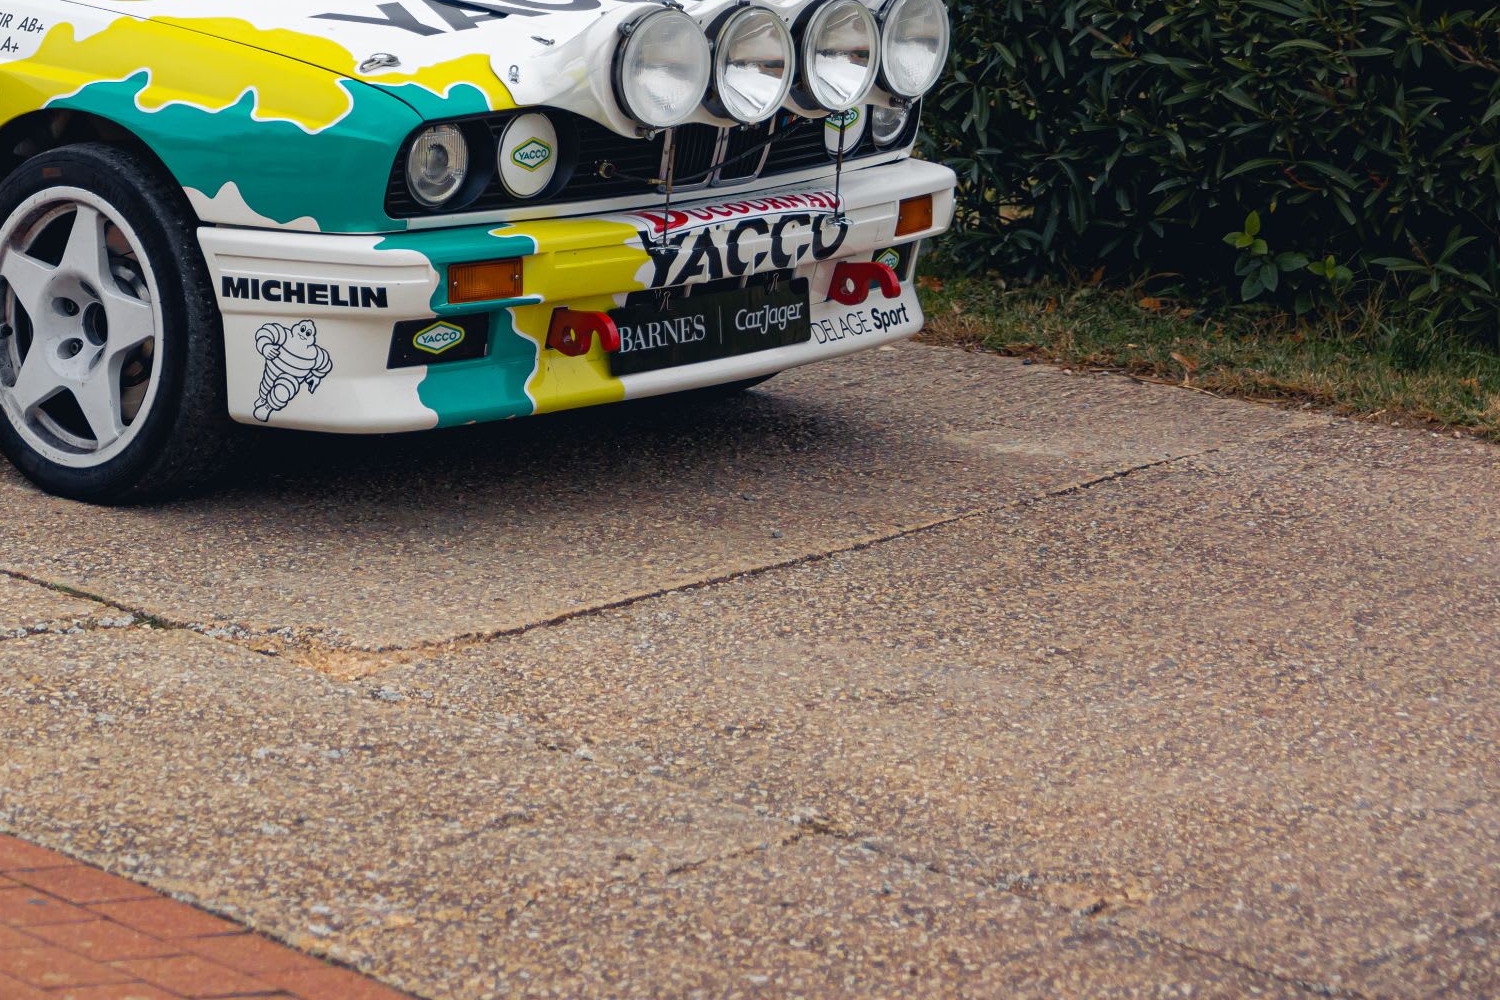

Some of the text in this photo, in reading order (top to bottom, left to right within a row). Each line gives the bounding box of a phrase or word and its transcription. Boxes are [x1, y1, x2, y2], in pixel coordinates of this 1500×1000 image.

[17, 16, 44, 34] AB+
[0, 36, 20, 53] A+
[518, 148, 547, 161] YACCO
[632, 190, 841, 233] DUCOURNAU
[637, 212, 849, 288] YACCO
[221, 275, 388, 308] MICHELIN
[421, 331, 457, 344] YACCO
[617, 302, 804, 354] BARNES CarJager
[810, 302, 909, 344] DELAGE Sport
